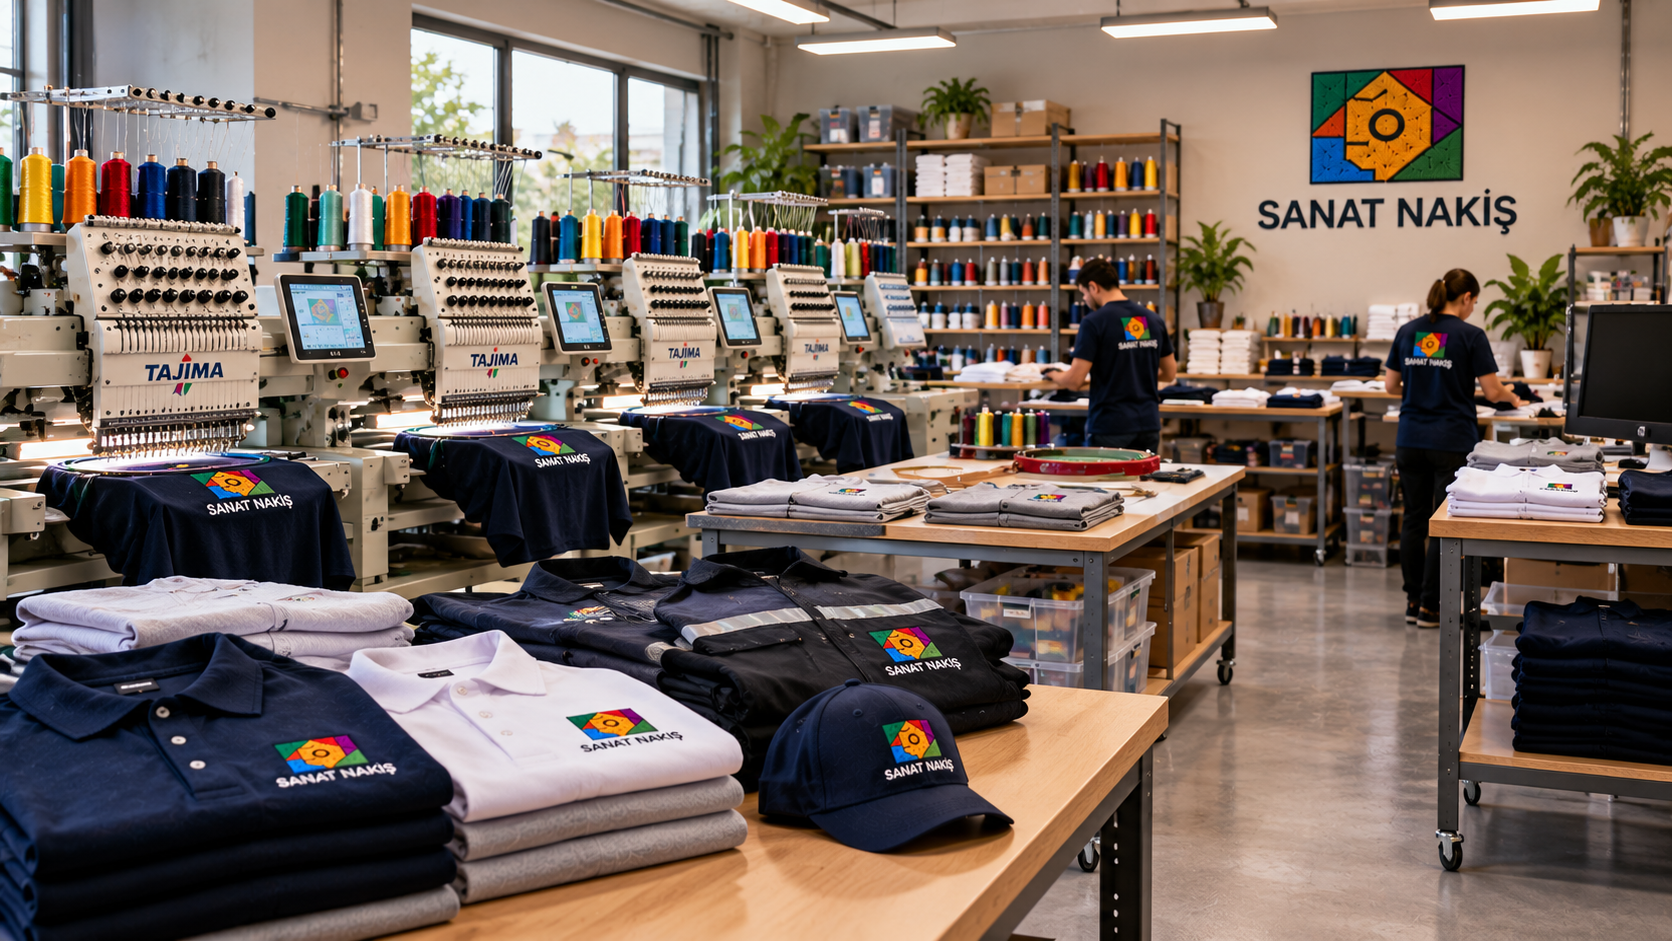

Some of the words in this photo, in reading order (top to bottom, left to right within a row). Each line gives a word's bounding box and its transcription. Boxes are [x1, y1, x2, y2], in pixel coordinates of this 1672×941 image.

[1258, 199, 1385, 230] SANAT
[1397, 188, 1518, 235] NAKİŞ
[471, 353, 518, 367] TAJIMA
[145, 362, 224, 381] TAJIMA
[206, 499, 251, 516] SANAT
[885, 662, 924, 676] SANAT
[580, 737, 631, 753] SANAT
[275, 770, 336, 788] SANAT
[884, 762, 923, 781] SANAT
